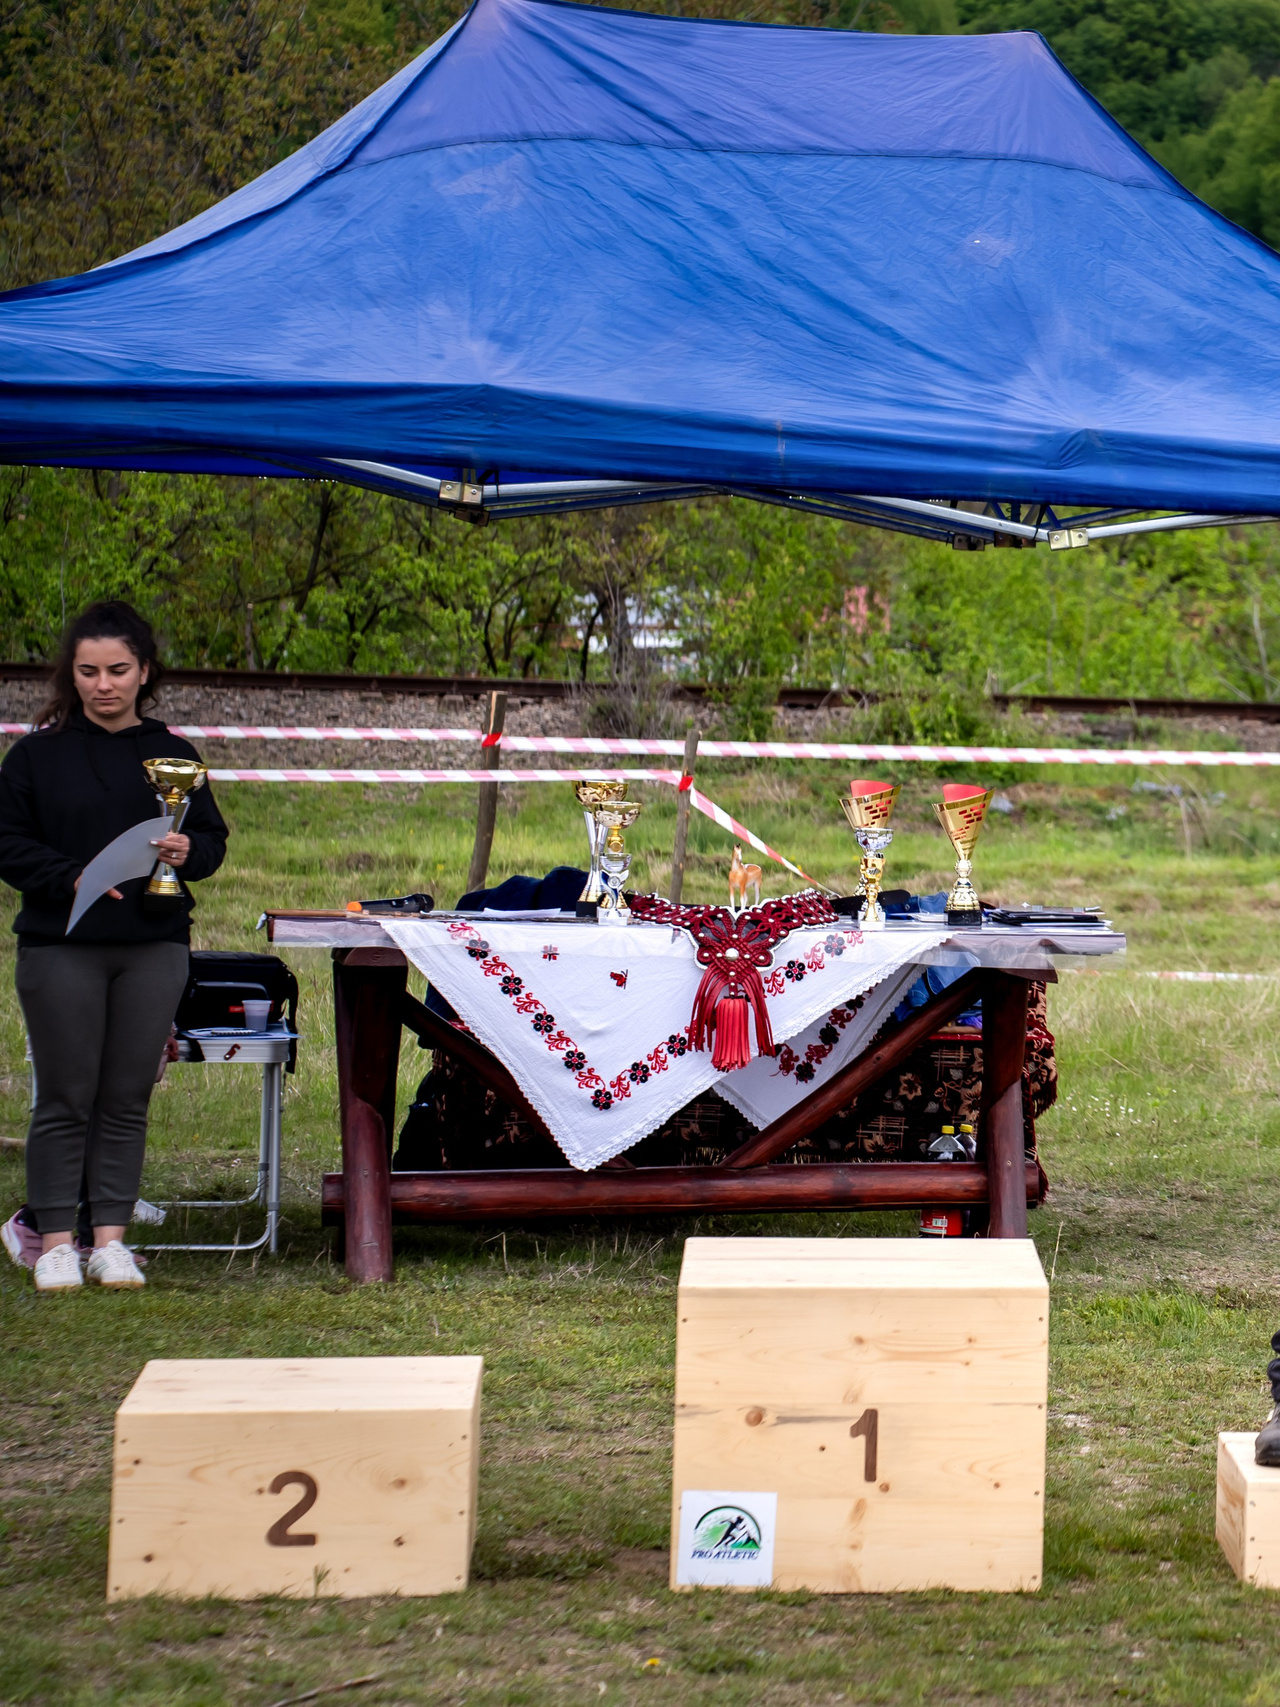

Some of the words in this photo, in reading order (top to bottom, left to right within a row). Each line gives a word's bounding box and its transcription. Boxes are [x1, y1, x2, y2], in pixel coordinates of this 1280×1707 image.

[850, 1409, 878, 1482] 1
[265, 1471, 318, 1547] 2
[690, 1550, 713, 1559] PRO
[713, 1550, 760, 1560] ATLETIC
